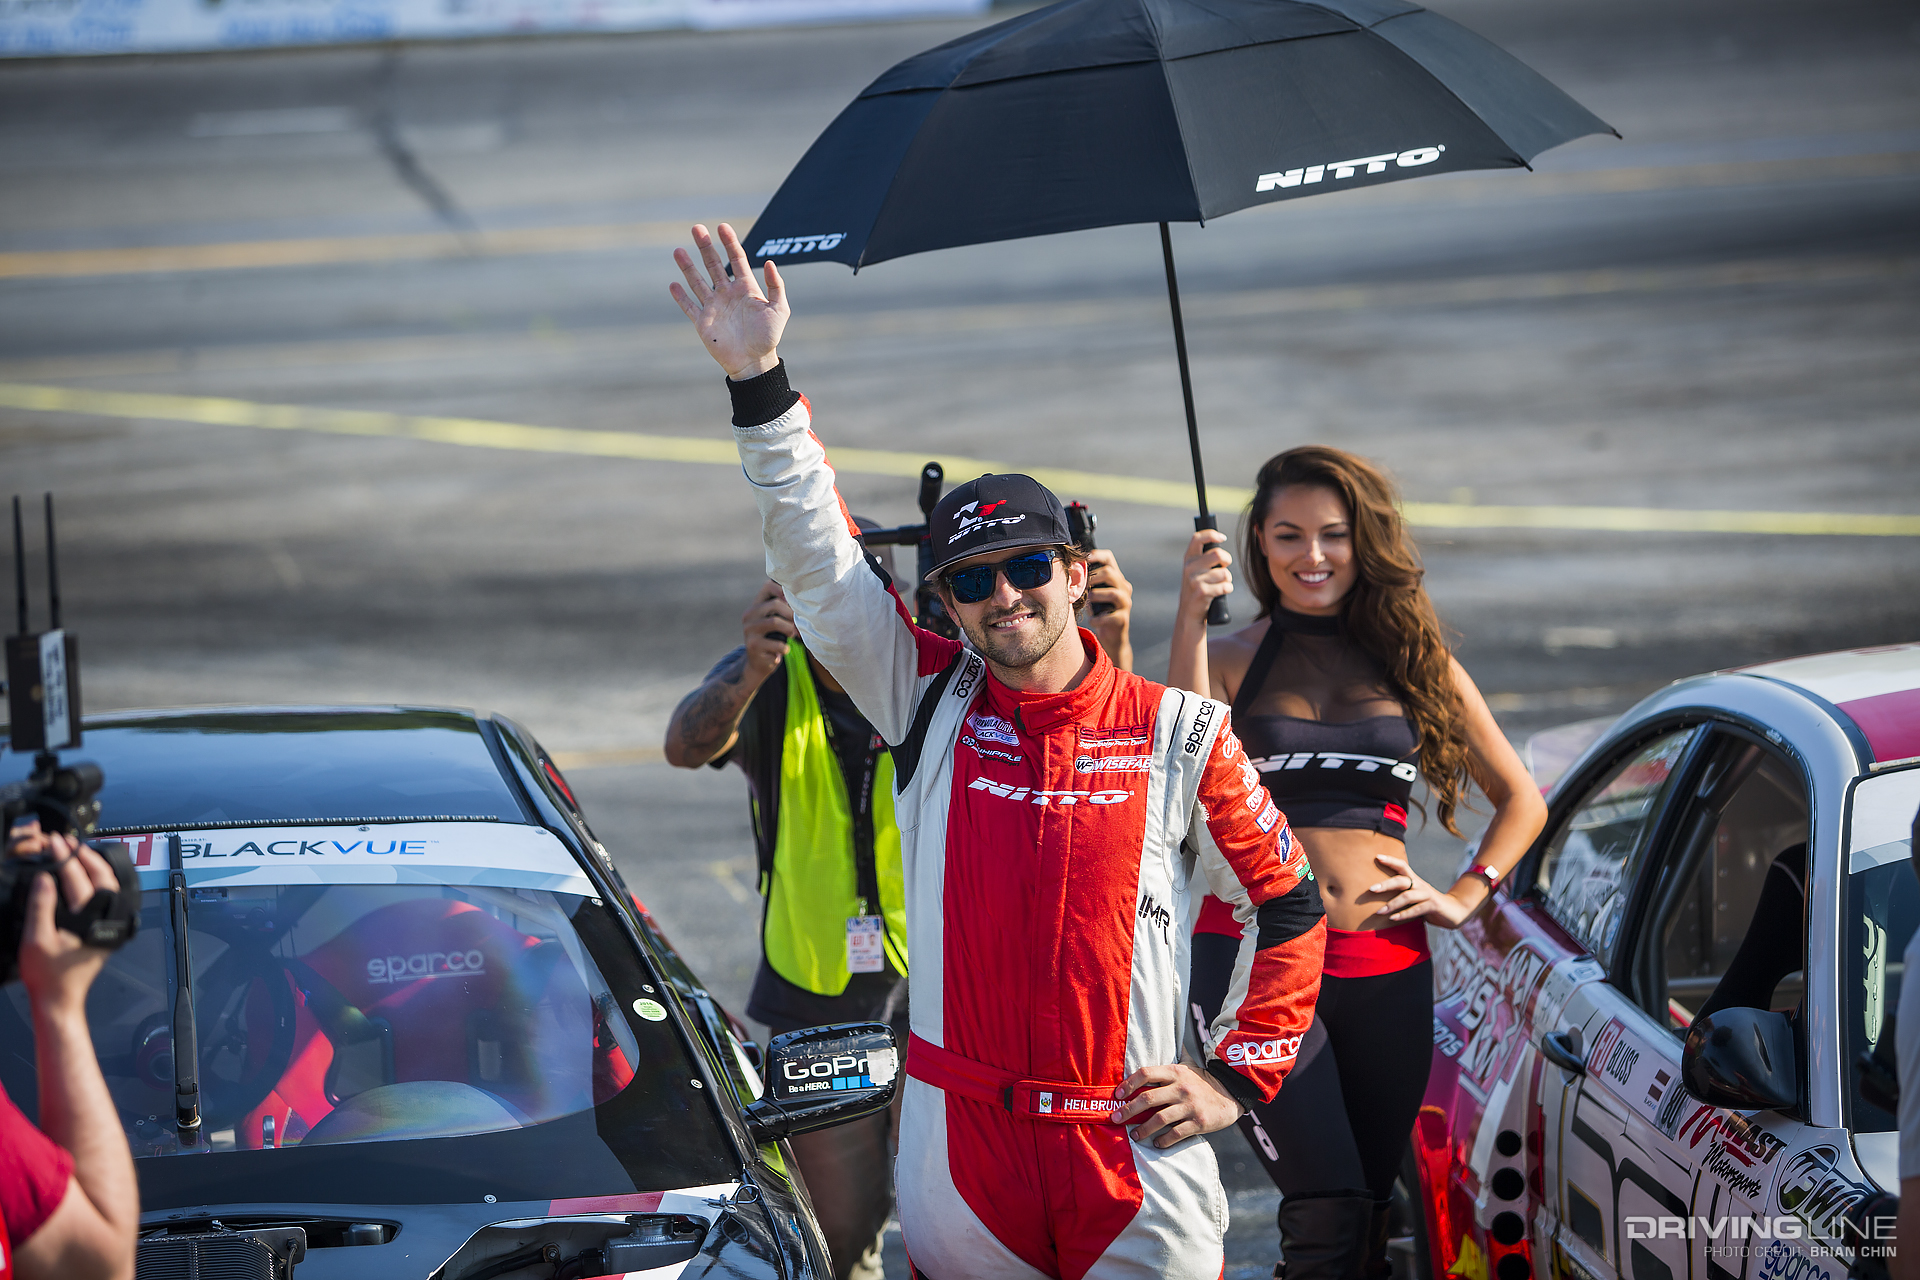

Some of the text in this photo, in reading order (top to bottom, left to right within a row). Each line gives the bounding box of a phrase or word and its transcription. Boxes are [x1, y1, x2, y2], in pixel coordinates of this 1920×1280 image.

[1256, 147, 1441, 192] NITTO
[756, 232, 843, 257] NITTO
[948, 517, 1022, 545] NITTO
[1184, 701, 1214, 756] sparco
[1251, 752, 1417, 782] NITTO
[968, 777, 1130, 805] NITTO
[181, 840, 427, 858] BLACKVUE
[367, 949, 484, 984] sparco
[783, 1056, 869, 1080] GoPr
[1719, 1111, 1787, 1164] MAST
[1702, 1142, 1762, 1199] Motorsports
